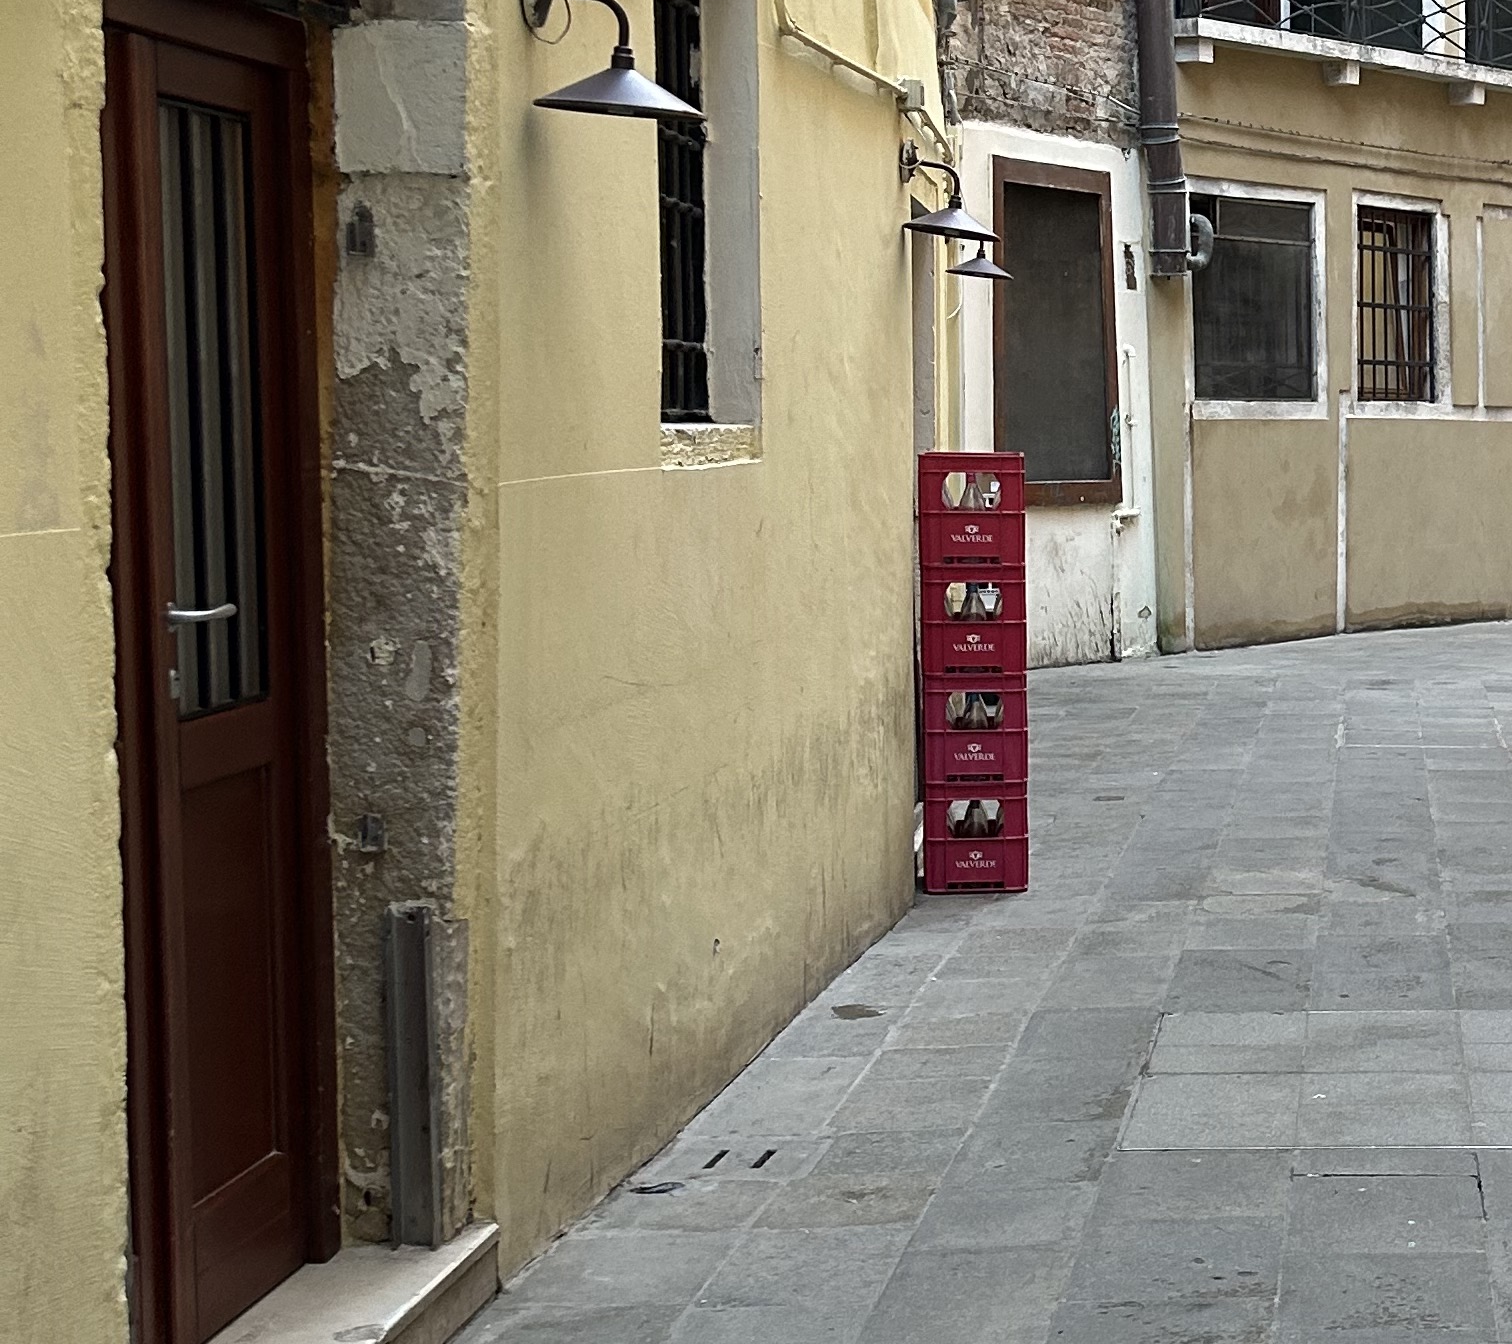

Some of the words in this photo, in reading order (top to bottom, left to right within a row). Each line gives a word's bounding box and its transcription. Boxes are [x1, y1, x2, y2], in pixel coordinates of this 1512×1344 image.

[950, 534, 993, 543] VALVERDE
[952, 643, 995, 652] VALVERDE
[954, 752, 996, 761] VALVERDE
[955, 860, 996, 869] VALVERDE
